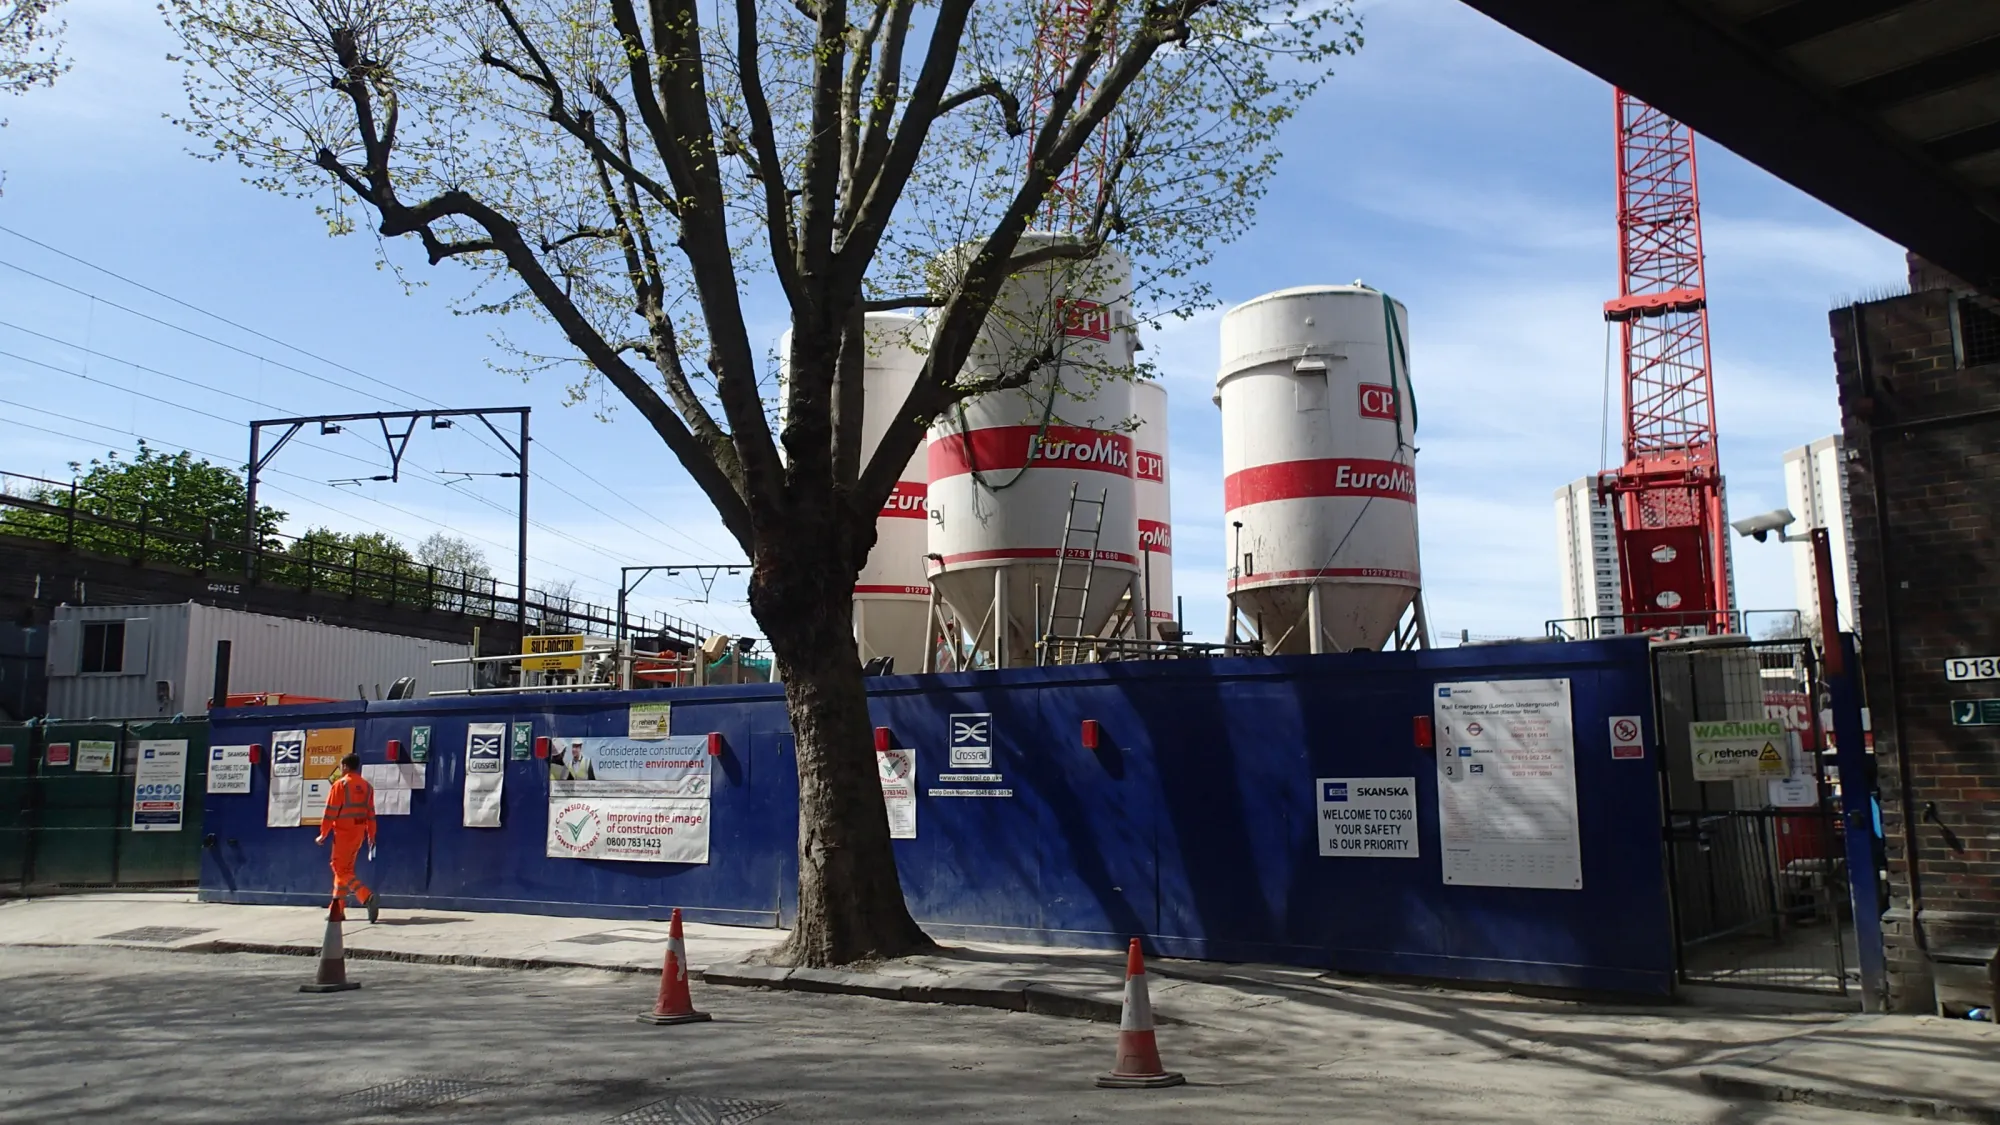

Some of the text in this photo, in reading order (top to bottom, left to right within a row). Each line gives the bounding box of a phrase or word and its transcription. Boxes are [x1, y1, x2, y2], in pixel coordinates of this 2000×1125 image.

[1362, 389, 1394, 414] CP
[1027, 434, 1128, 468] EuroMix
[1137, 455, 1162, 478] CPI
[1335, 465, 1415, 496] EuroMix
[1055, 549, 1085, 557] 0279
[1445, 726, 1450, 735] 1
[1693, 722, 1780, 738] WARNING
[310, 745, 343, 753] WELCOME
[599, 745, 700, 756] Considerate constructors
[1445, 748, 1452, 756] 2
[1714, 748, 1758, 758] rehene
[955, 750, 987, 760] Crossrail
[472, 760, 497, 769] Crossrail
[598, 758, 705, 771] protect the environment
[1446, 767, 1453, 775] 3
[1356, 787, 1409, 796] SKANSKA
[556, 803, 601, 826] CONSIDERATE
[606, 811, 702, 826] Improving the image
[1323, 809, 1412, 820] WELCOME TO C360
[606, 823, 673, 835] of construction
[1334, 824, 1402, 835] YOUR SAFETY
[554, 829, 600, 853] CONSTRUCTORS
[606, 837, 662, 848] 0800 783 1423
[1329, 838, 1409, 850] IS OUR PRIORITY
